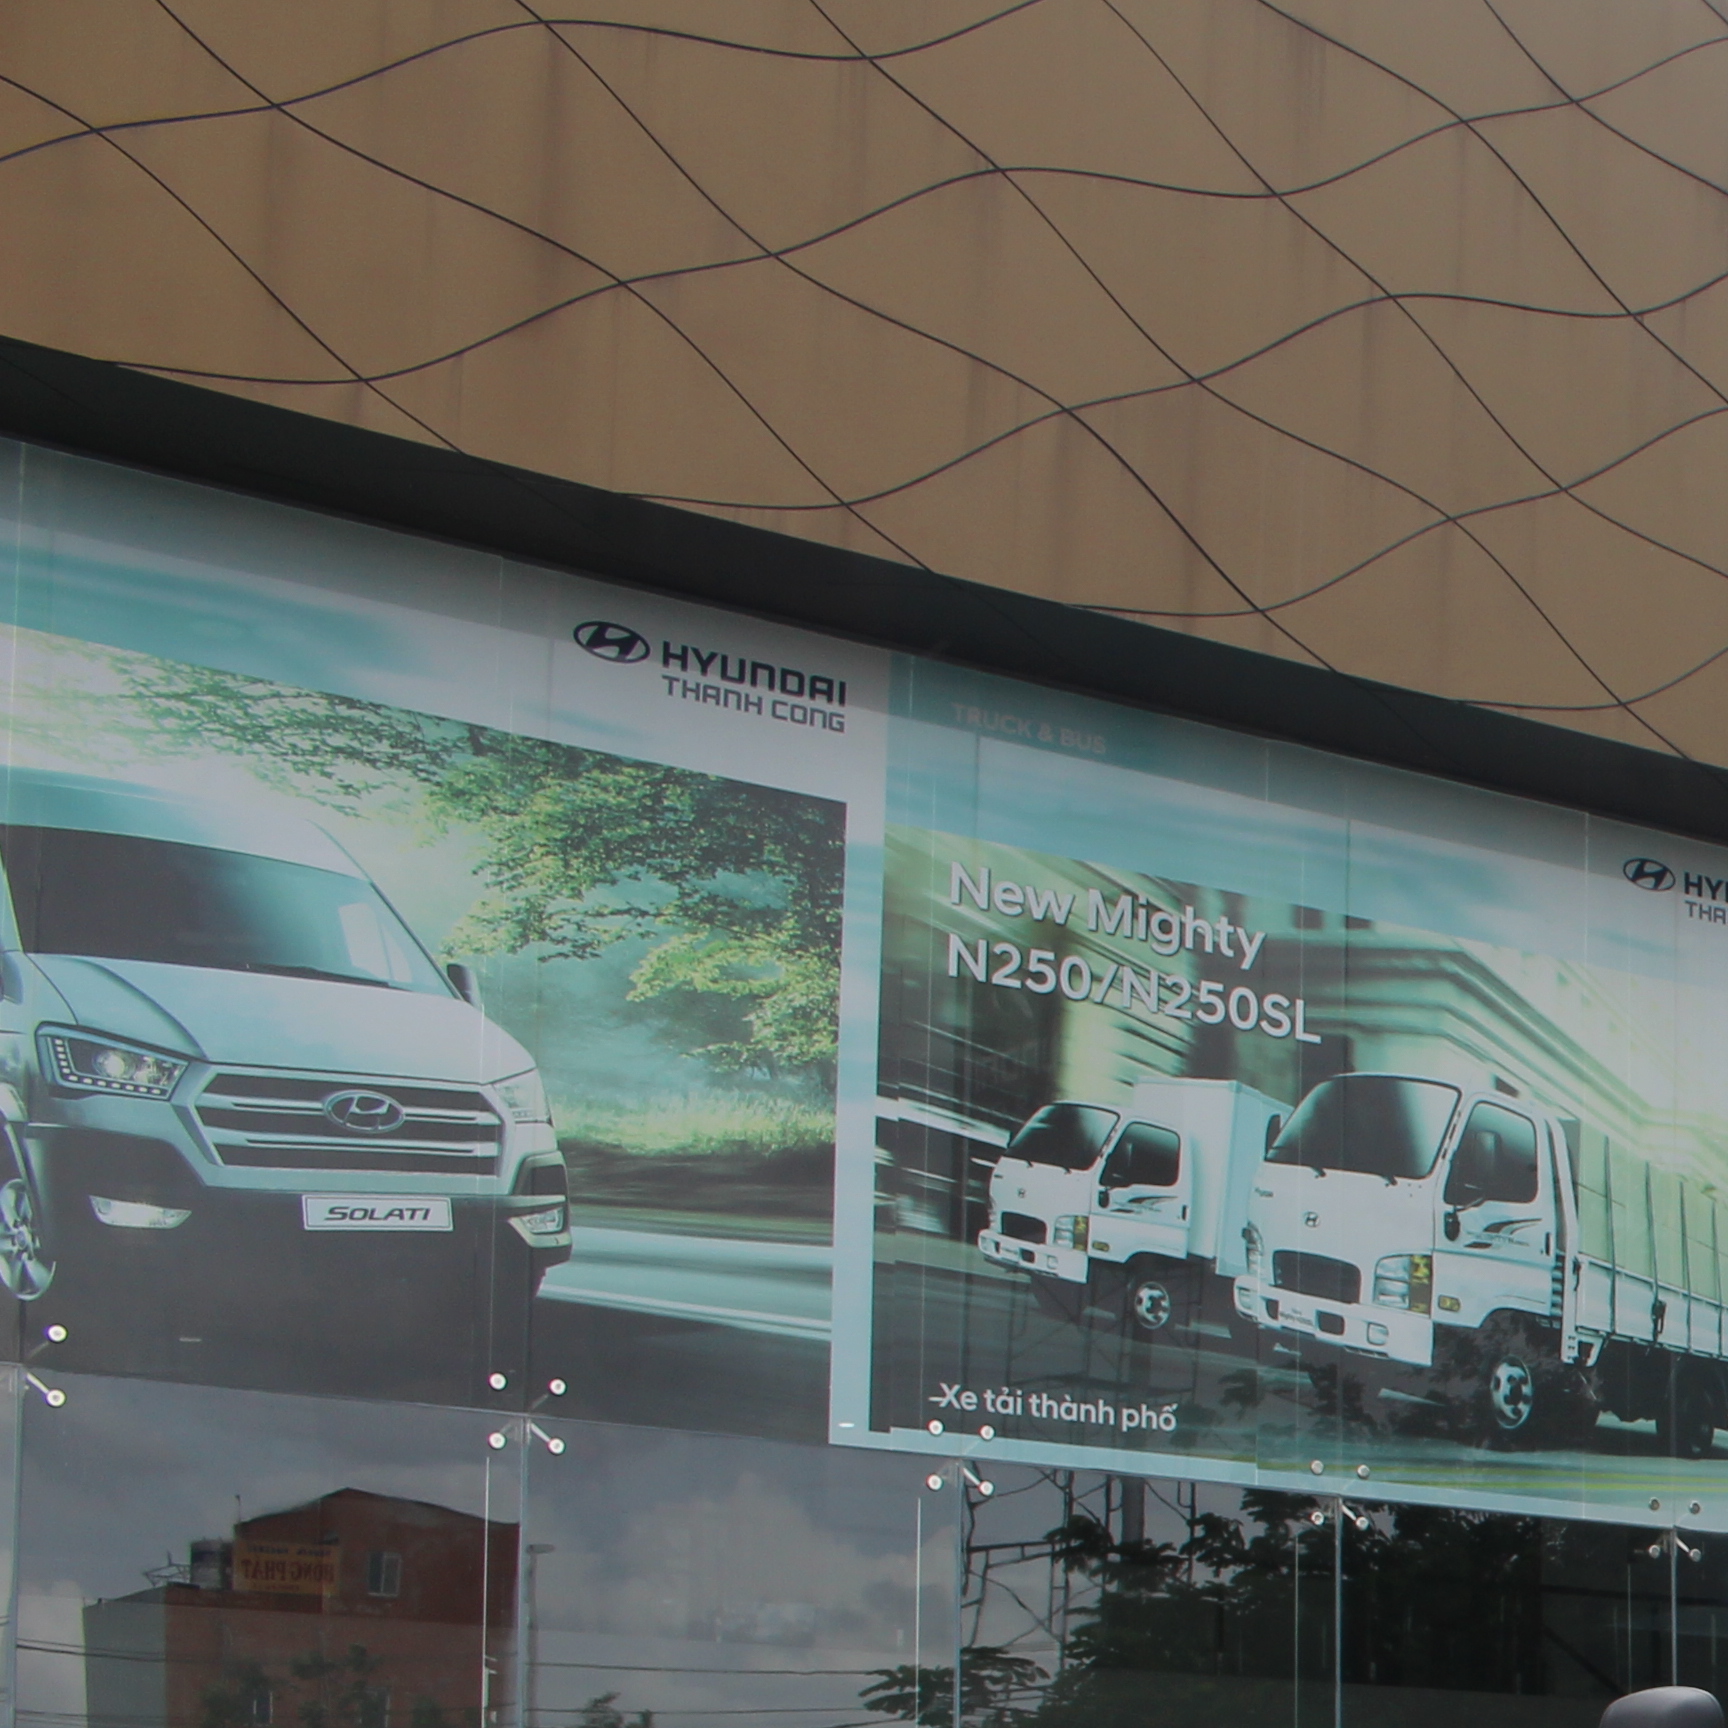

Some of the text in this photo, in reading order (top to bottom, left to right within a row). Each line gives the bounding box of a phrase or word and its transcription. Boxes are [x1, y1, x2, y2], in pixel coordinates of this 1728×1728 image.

[661, 674, 845, 733] THANH CONG
[662, 641, 847, 707] HYUNDAI
[952, 702, 1106, 754] TRUCK & BUS
[950, 861, 1266, 971] New Mighty
[947, 932, 1322, 1045] N250/N250SL
[324, 1206, 431, 1222] SOLATI
[938, 1382, 1179, 1432] Xe tải thành phố
